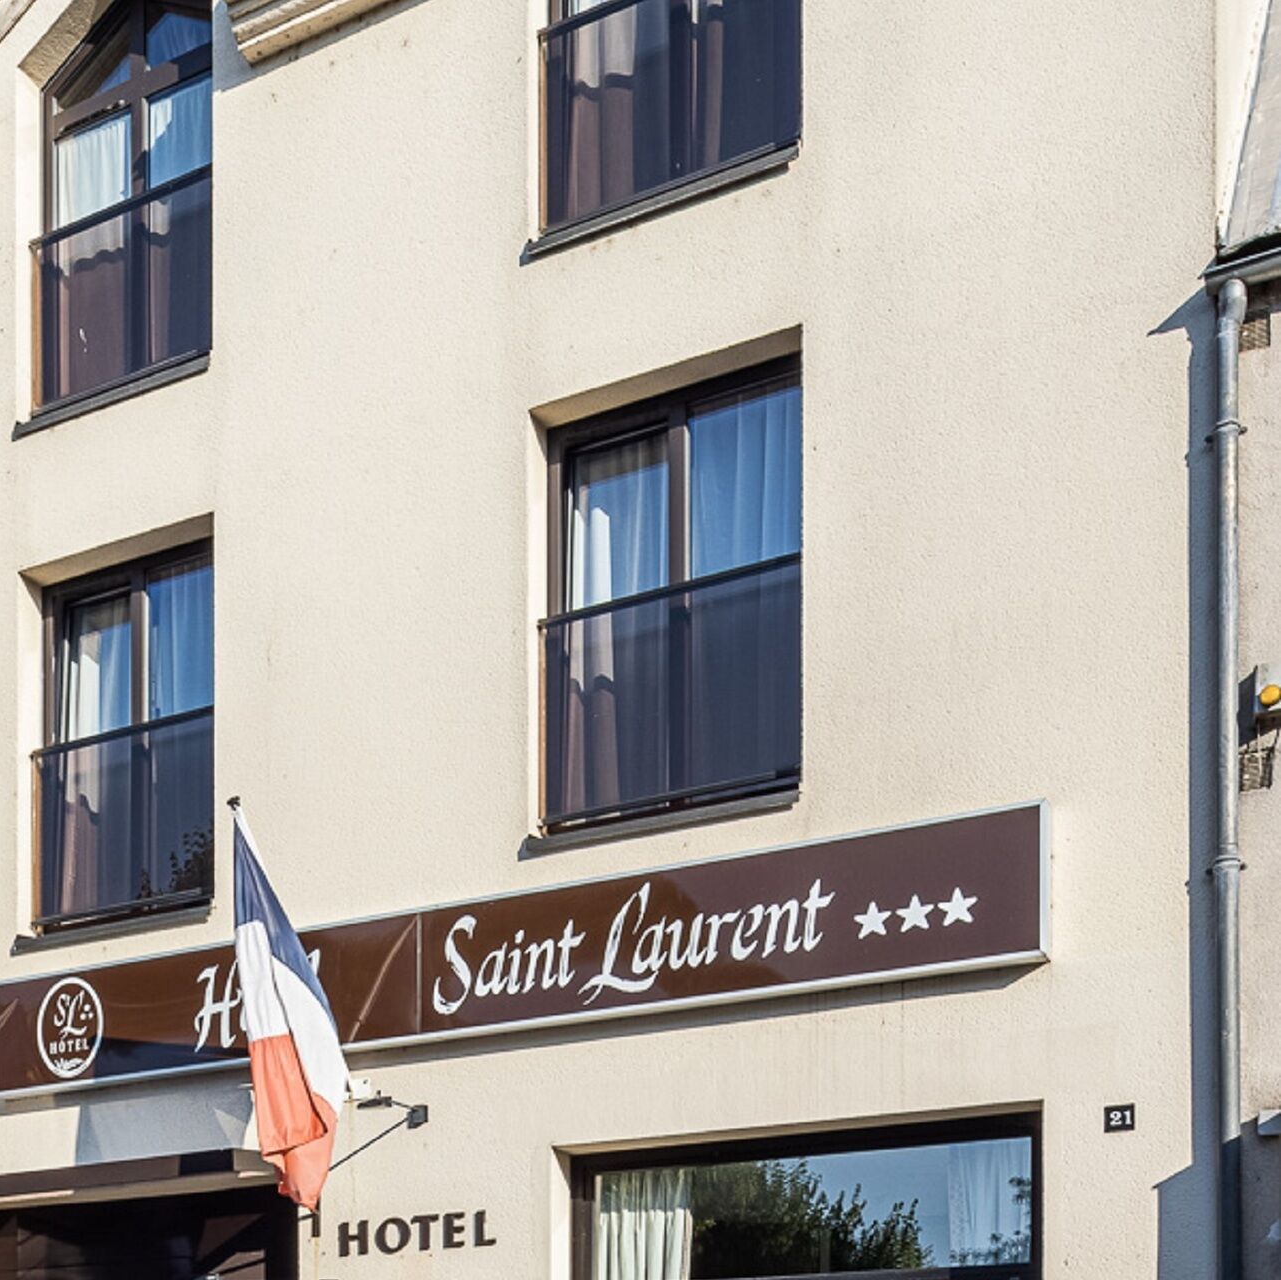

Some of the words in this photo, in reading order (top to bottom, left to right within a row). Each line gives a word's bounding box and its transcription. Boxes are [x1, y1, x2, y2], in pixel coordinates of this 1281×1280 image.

[432, 914, 587, 1015] Saint
[578, 878, 836, 1005] Laurent
[1109, 1110, 1132, 1126] 21
[337, 1209, 498, 1257] HOTEL
